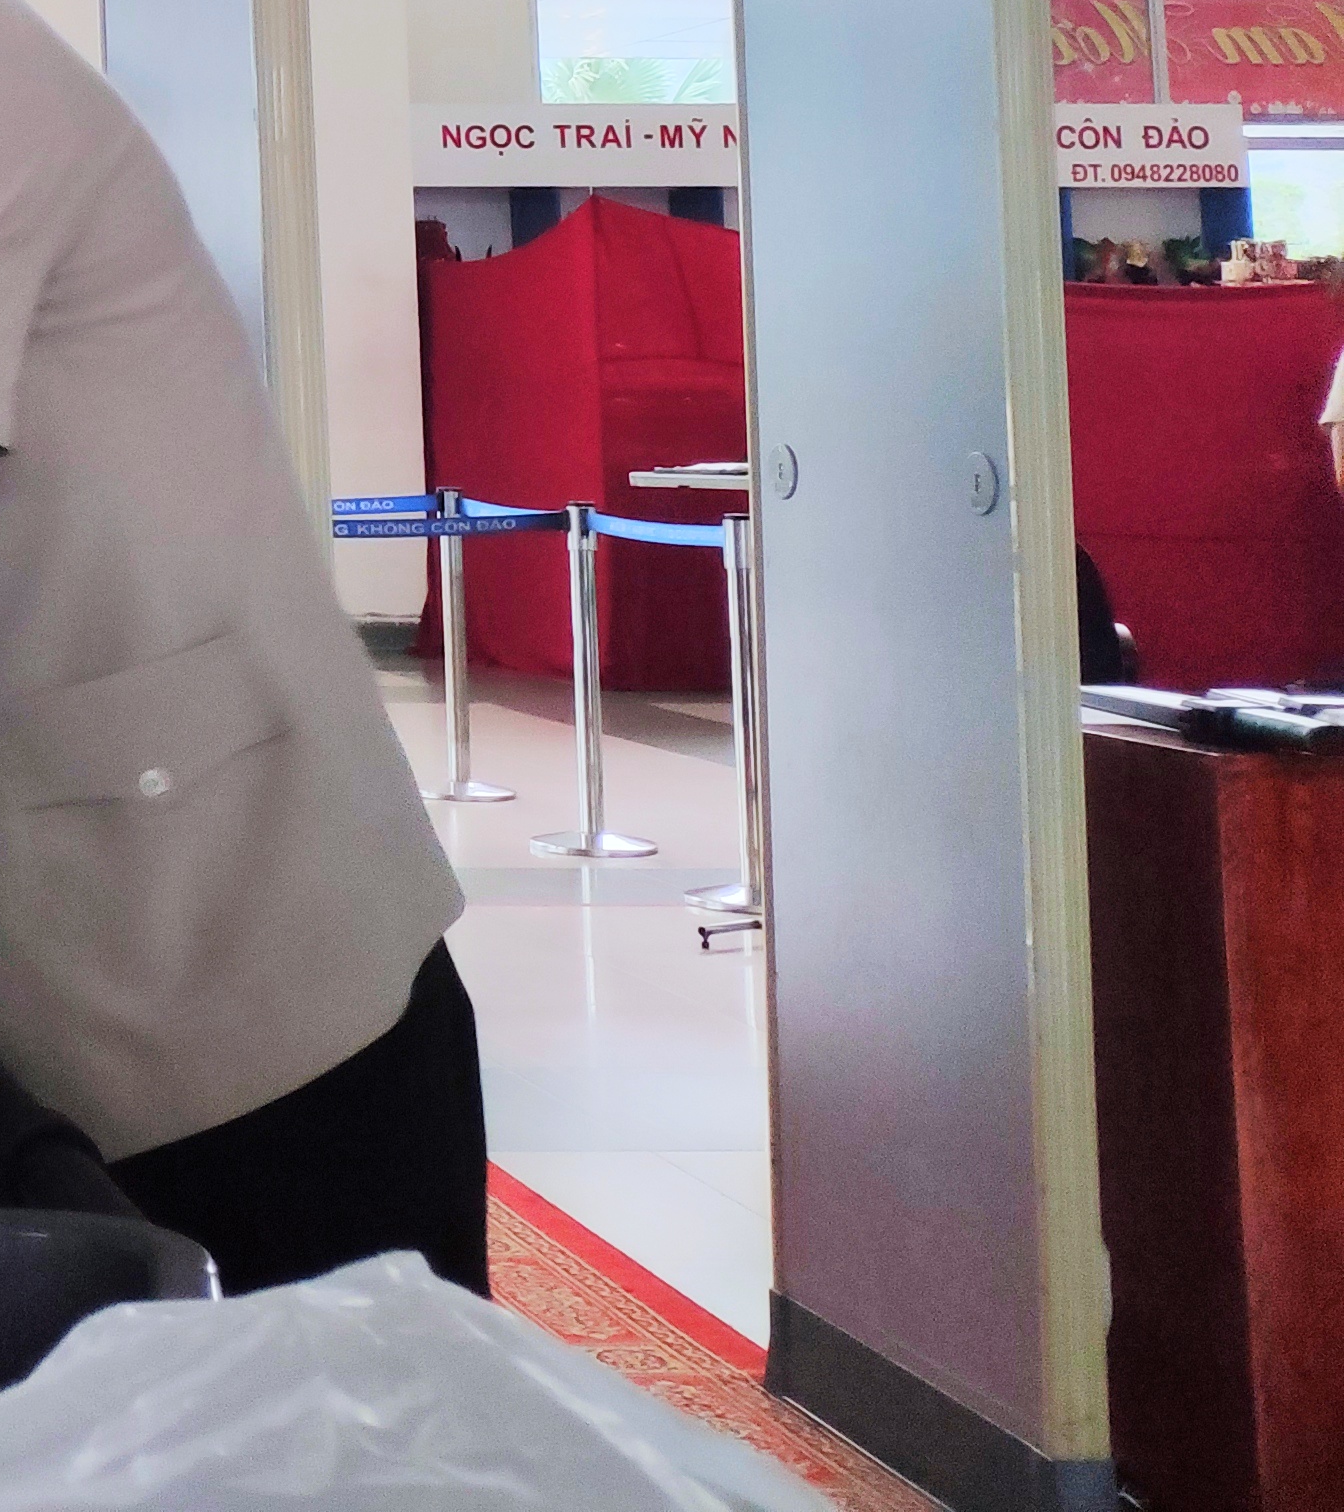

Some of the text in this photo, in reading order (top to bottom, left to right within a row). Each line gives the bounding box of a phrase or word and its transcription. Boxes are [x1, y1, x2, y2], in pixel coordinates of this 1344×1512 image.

[440, 123, 536, 157] NGỌC
[1056, 117, 1123, 150] CÔN
[1141, 117, 1210, 150] ĐẢO
